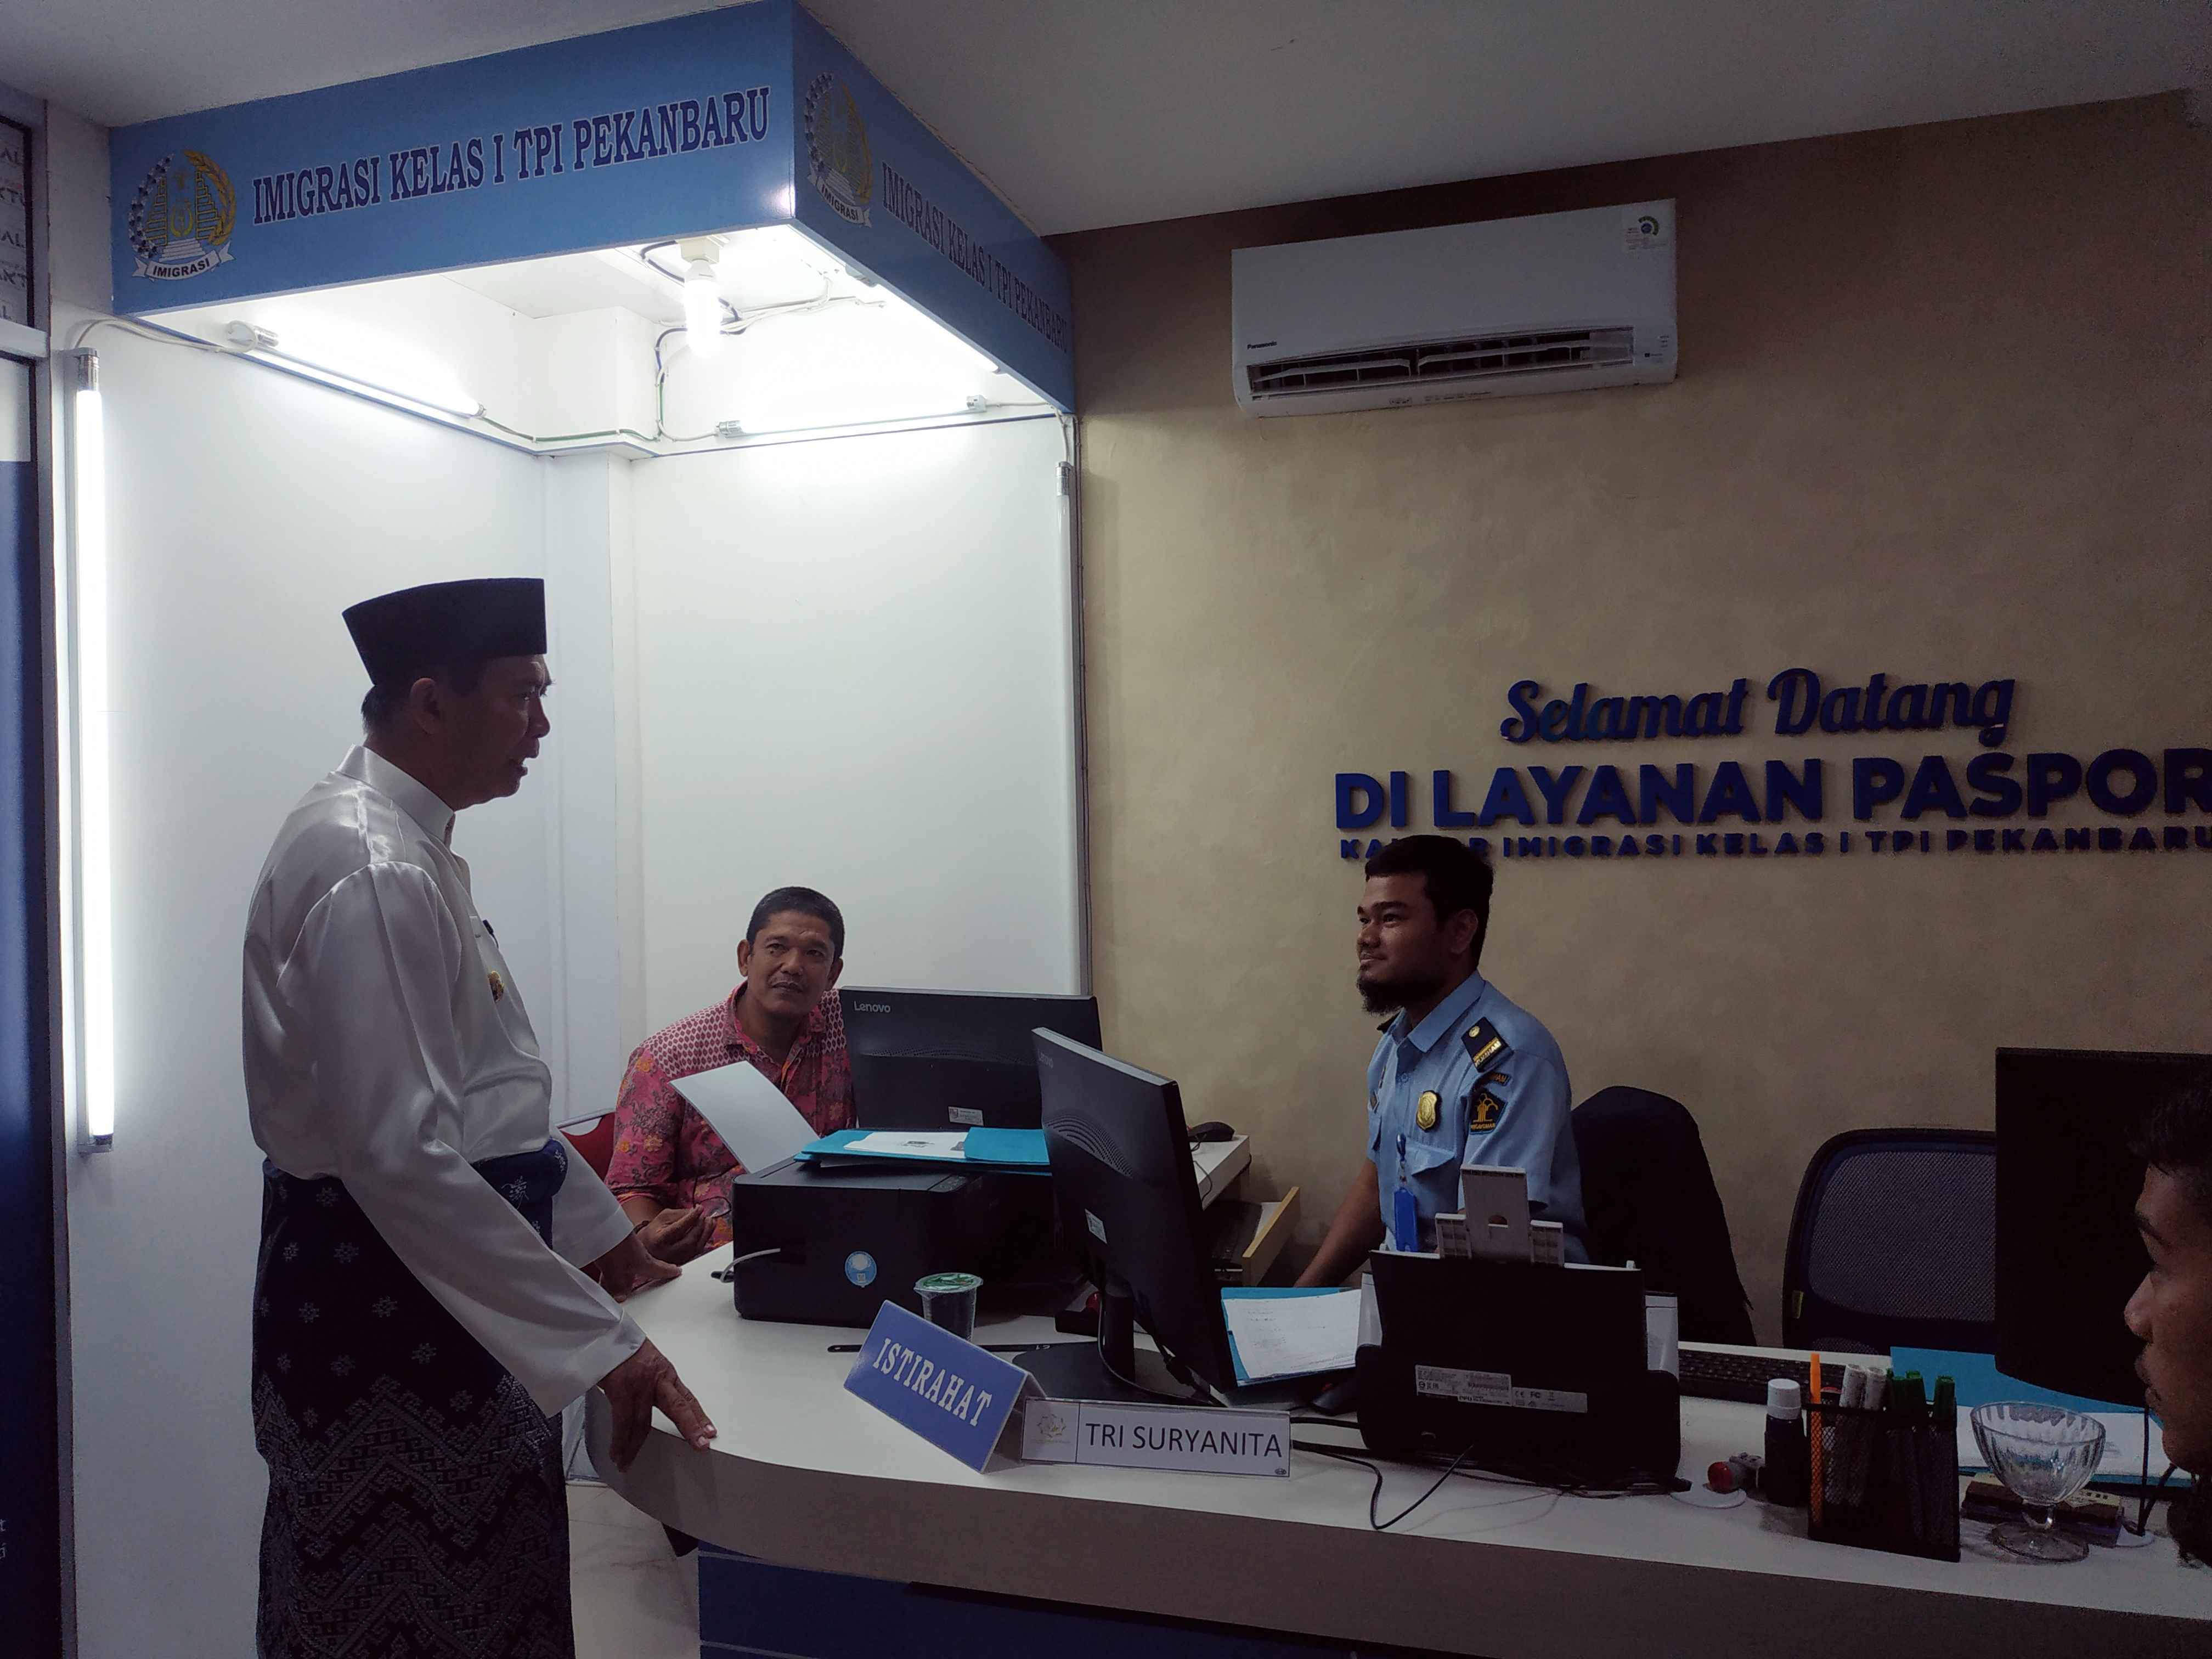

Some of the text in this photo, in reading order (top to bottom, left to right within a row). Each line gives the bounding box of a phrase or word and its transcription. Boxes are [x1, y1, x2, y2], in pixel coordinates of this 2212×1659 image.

[253, 86, 770, 226] IMIGRASI KELAS I TPI PEKANBARU
[821, 184, 859, 221] IMIGRASI
[153, 257, 211, 278] IMIGRASI
[882, 161, 1068, 354] IMIGRASI KELAS I TPI PEKANBARU
[1247, 341, 1278, 350] Panasonic
[1499, 668, 2016, 747] Selamat Datang
[1335, 748, 2212, 830] DI LAYANAN PASPOR
[1503, 833, 1681, 858] IMIGRASI
[1696, 831, 1825, 855] KELAS
[1840, 831, 1850, 854] I
[1865, 830, 1930, 854] TPI
[1946, 826, 2212, 852] PEKANBARU
[854, 1000, 891, 1013] Lenovo
[872, 1338, 992, 1427] ISTIRAHAT
[1085, 1423, 1283, 1459] TRI SURYANITA
